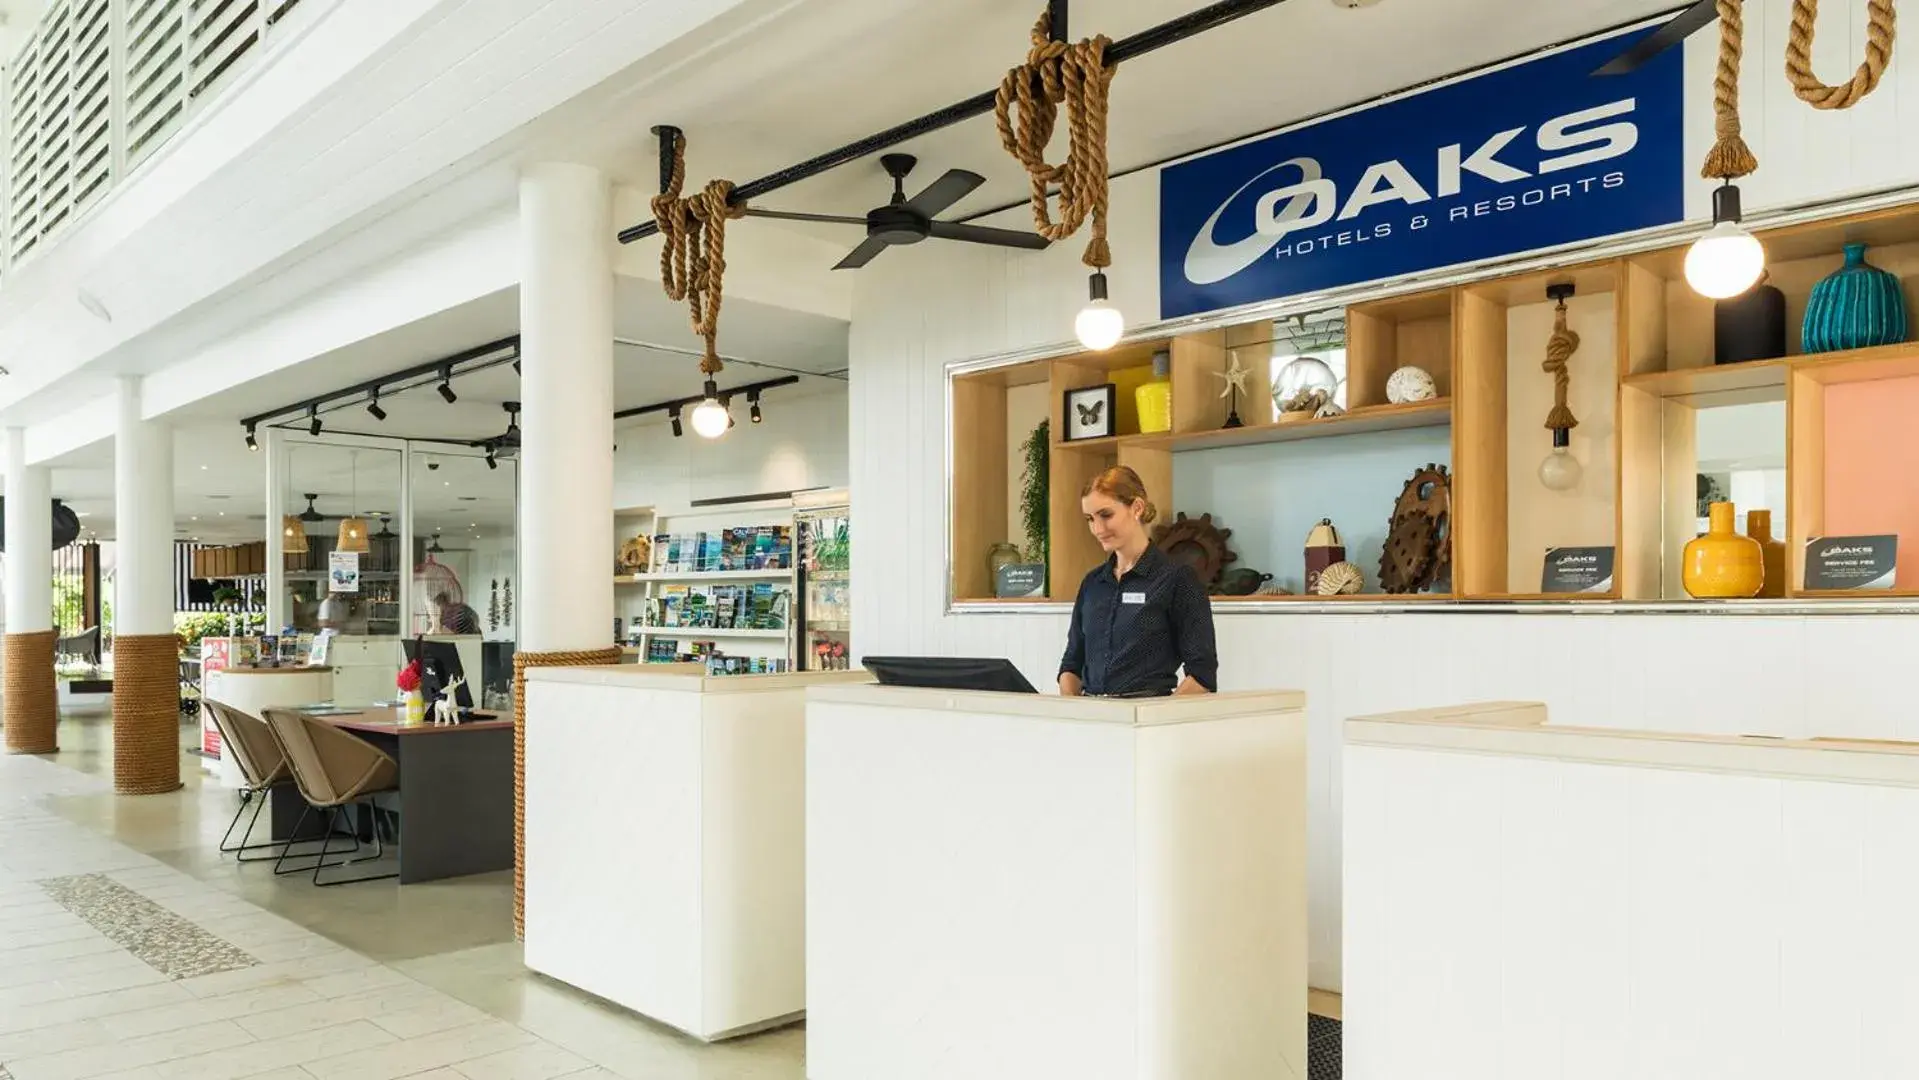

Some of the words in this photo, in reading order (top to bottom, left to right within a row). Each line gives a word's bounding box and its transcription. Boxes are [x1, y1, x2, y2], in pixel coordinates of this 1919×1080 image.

[1255, 97, 1639, 235] OAKS
[1275, 222, 1392, 259] HOTELS
[1410, 215, 1429, 231] &
[1450, 171, 1625, 222] RESORTS
